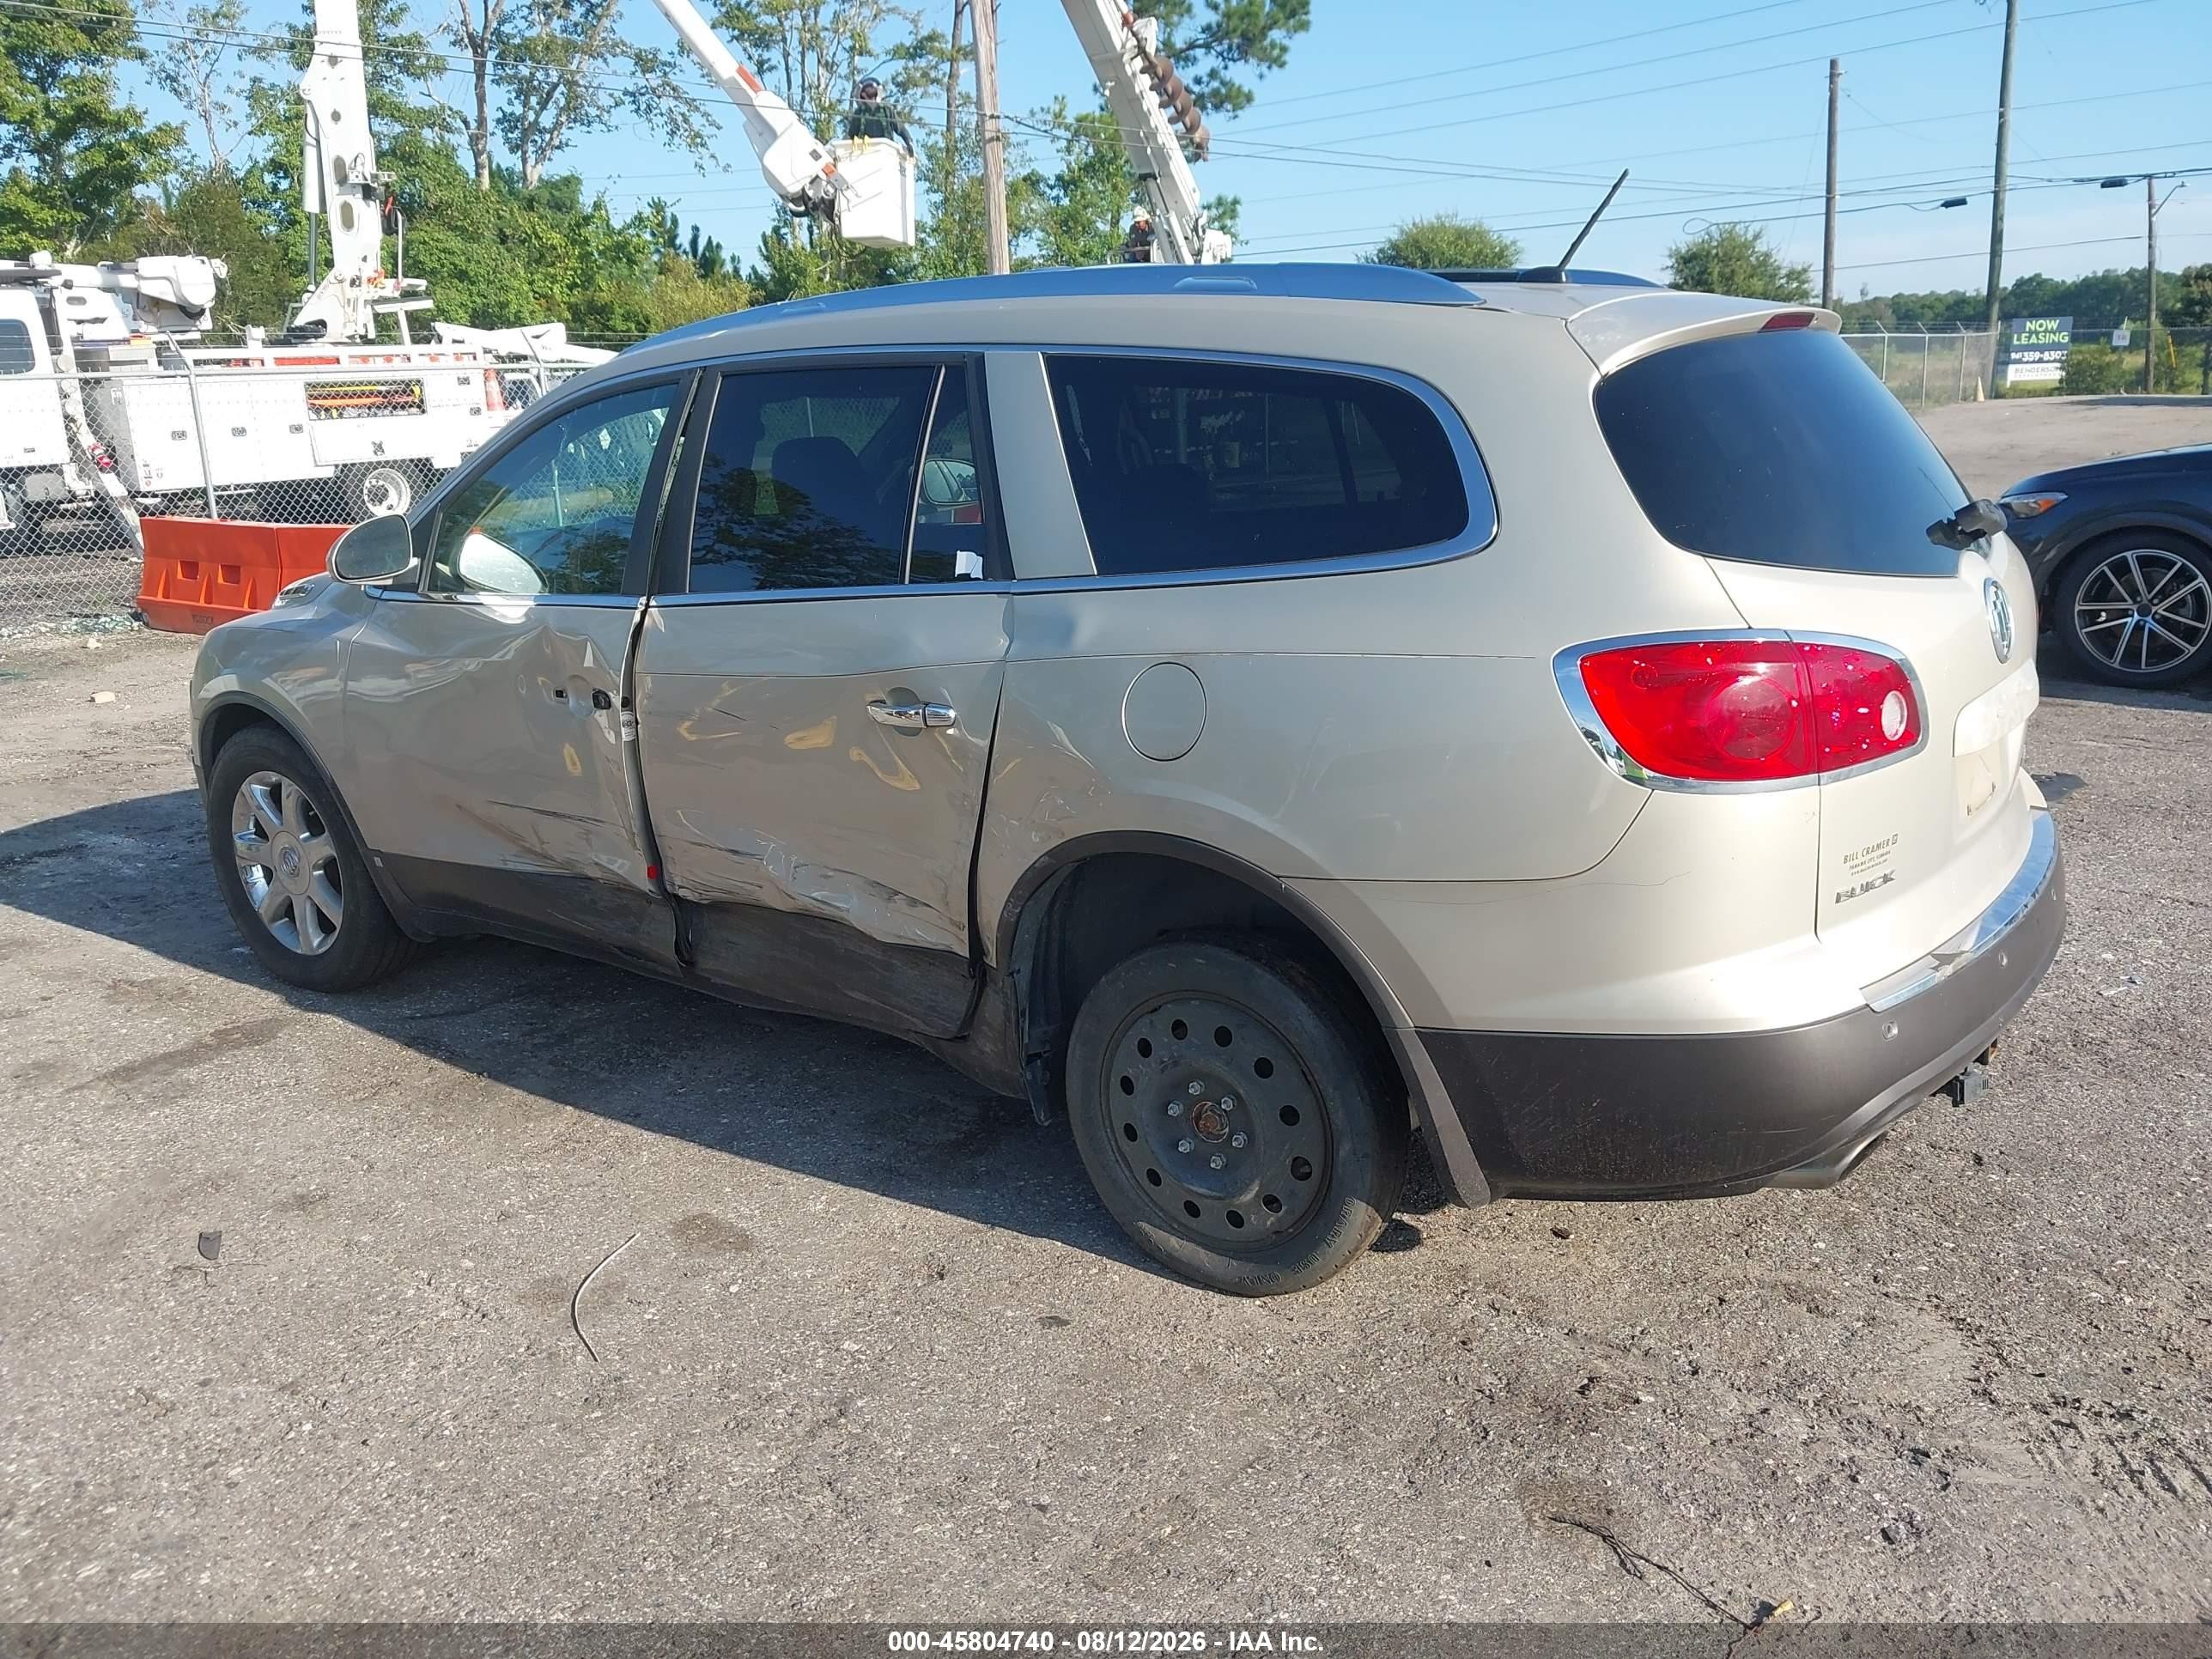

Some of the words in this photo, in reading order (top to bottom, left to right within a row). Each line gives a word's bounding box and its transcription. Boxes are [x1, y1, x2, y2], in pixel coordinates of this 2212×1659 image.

[2026, 319, 2060, 331] NOW
[2013, 331, 2069, 344] LEASING
[1844, 851, 1859, 865] BILL
[1862, 838, 1891, 858] CRAMER
[1835, 869, 1897, 904] BUICK
